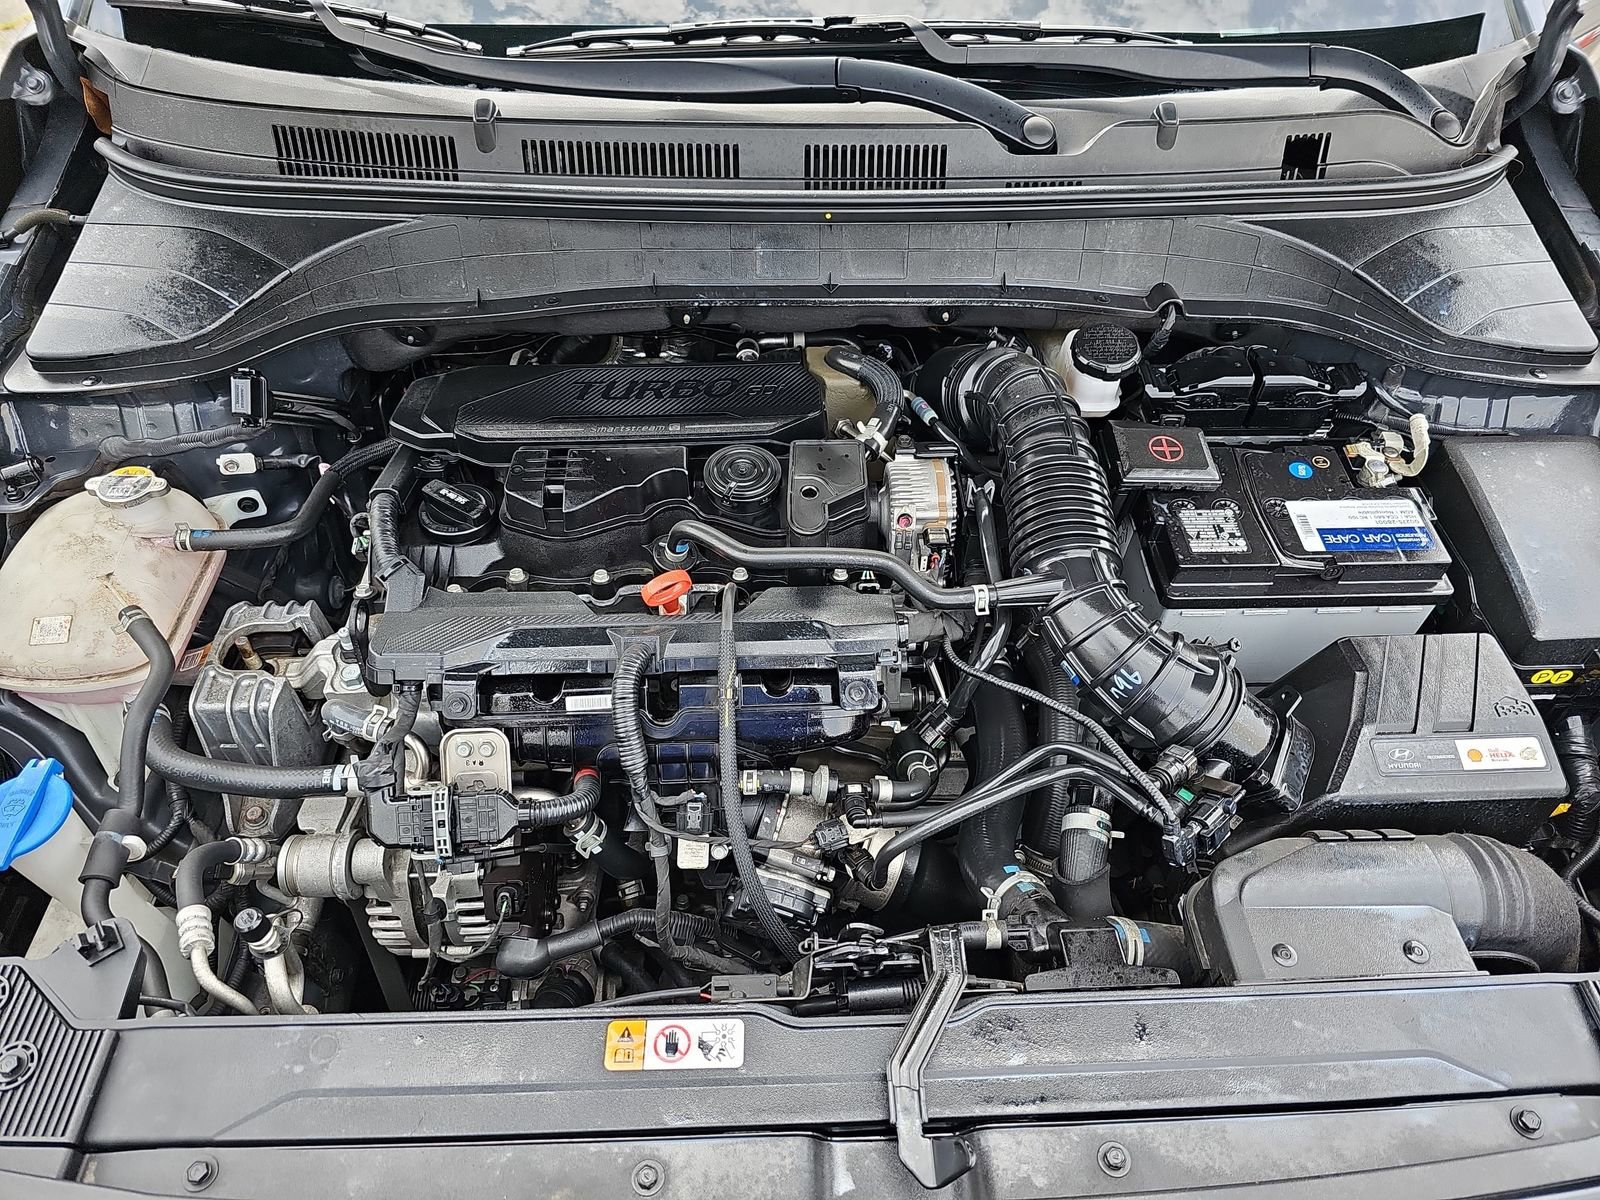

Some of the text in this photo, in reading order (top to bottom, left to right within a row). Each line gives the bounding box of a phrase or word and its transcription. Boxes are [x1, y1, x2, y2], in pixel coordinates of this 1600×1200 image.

[572, 378, 739, 400] TURBO
[590, 424, 666, 434] Smartstream
[1322, 533, 1392, 544] CAR CARE
